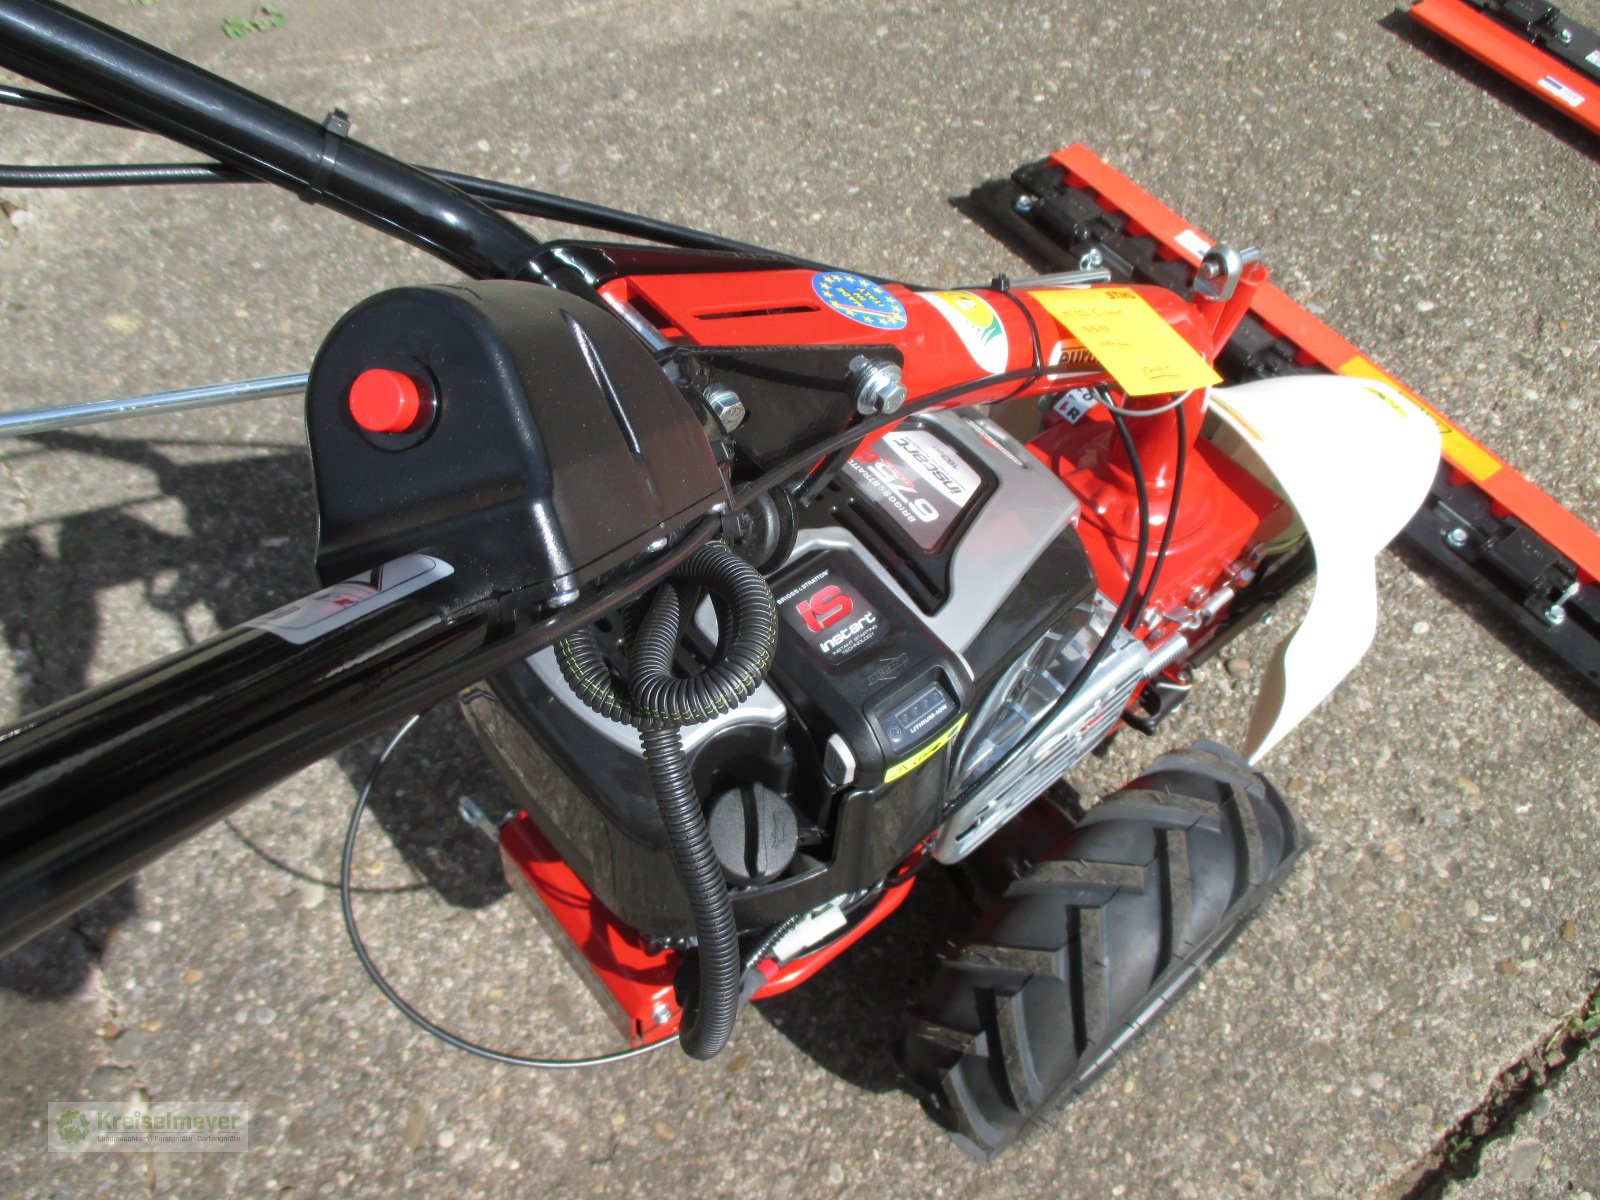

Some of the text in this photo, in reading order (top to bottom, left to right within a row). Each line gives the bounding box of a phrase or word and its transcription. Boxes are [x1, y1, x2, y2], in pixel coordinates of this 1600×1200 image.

[1105, 291, 1136, 299] STIHL
[820, 611, 876, 653] instart
[842, 631, 875, 655] TECHNOLOGY
[909, 704, 948, 734] LITHIUM-ION
